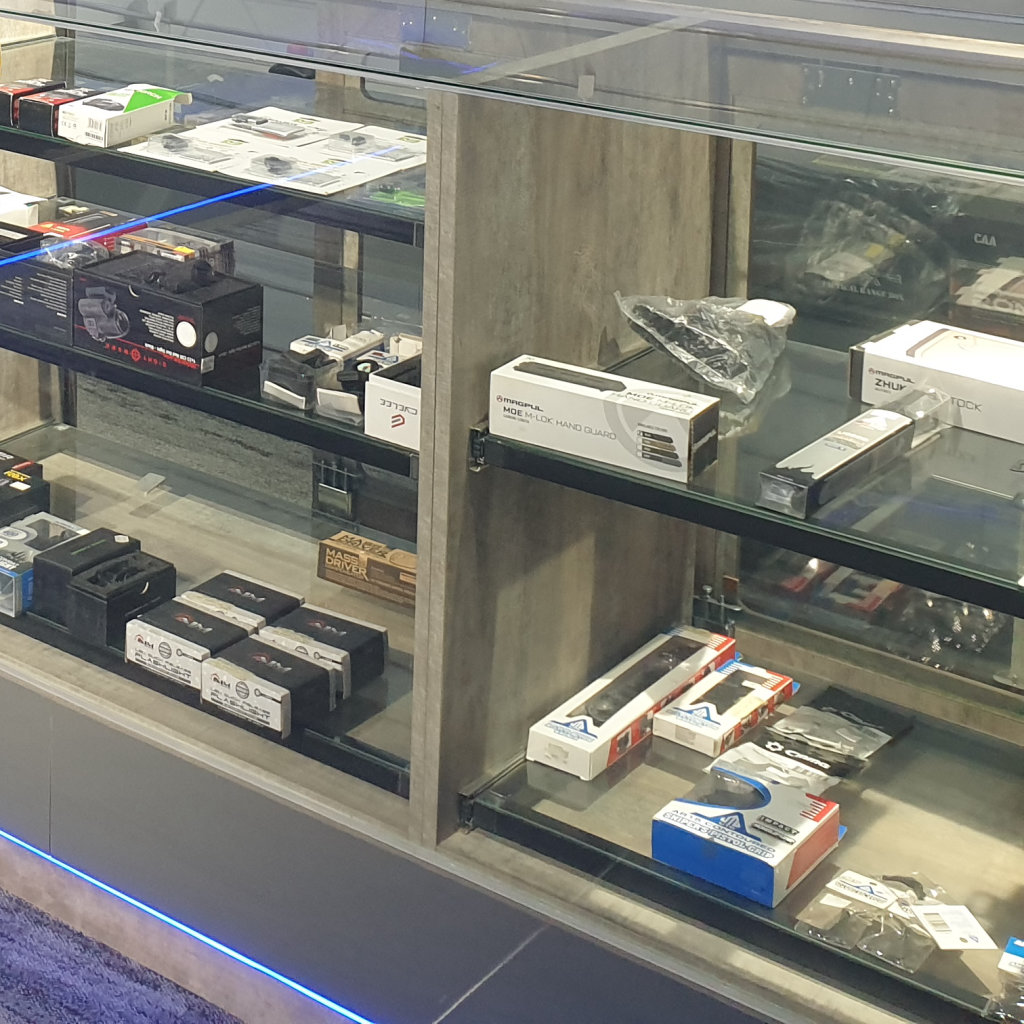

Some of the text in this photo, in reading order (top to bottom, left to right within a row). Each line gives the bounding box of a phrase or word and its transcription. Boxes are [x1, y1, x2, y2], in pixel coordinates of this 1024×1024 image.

[973, 233, 997, 247] CAA
[875, 370, 915, 384] MAGPUL
[504, 397, 544, 412] MAGPUL
[950, 397, 984, 413] TOCK
[503, 406, 617, 440] MOE M-LOK HAND GUARD
[326, 548, 358, 565] MASS
[325, 556, 369, 581] DRIVER
[135, 652, 192, 678] FLASHLIGHT
[210, 691, 271, 719] FLASHLIGHT
